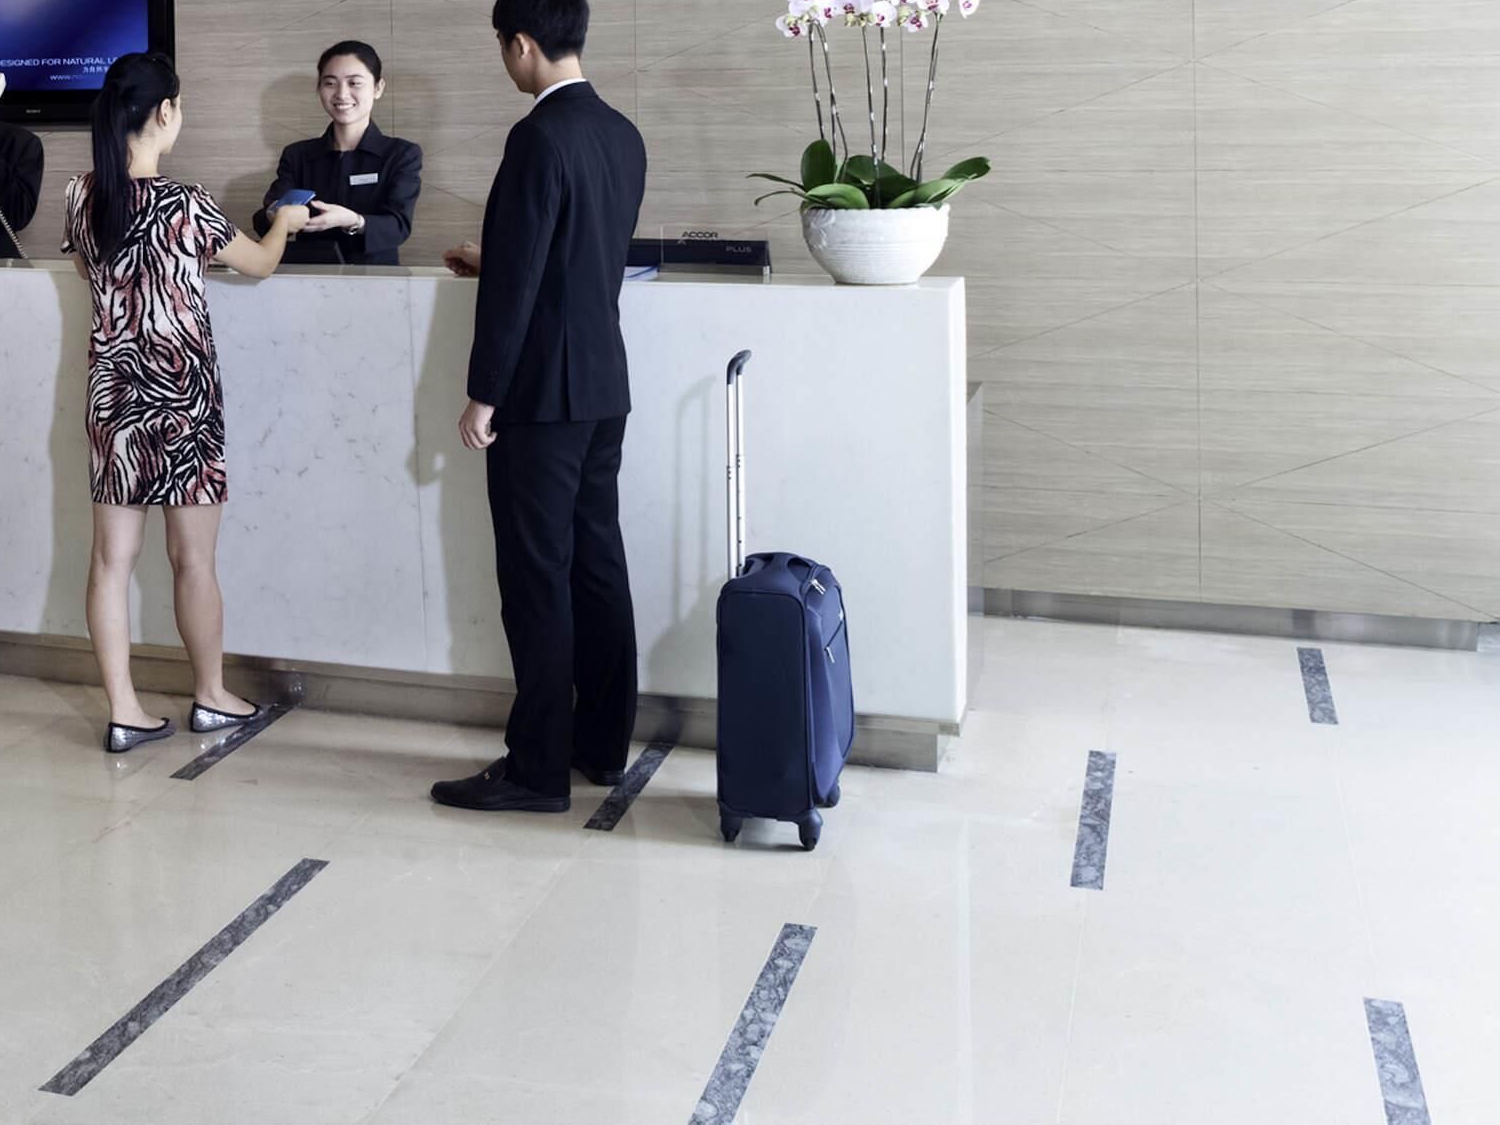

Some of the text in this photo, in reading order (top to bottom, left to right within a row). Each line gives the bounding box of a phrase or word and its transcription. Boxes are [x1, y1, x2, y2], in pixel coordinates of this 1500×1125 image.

[41, 58, 62, 66] FOR
[62, 57, 106, 66] NATURAL
[681, 231, 718, 239] ACCOR
[725, 245, 752, 253] PLUS
